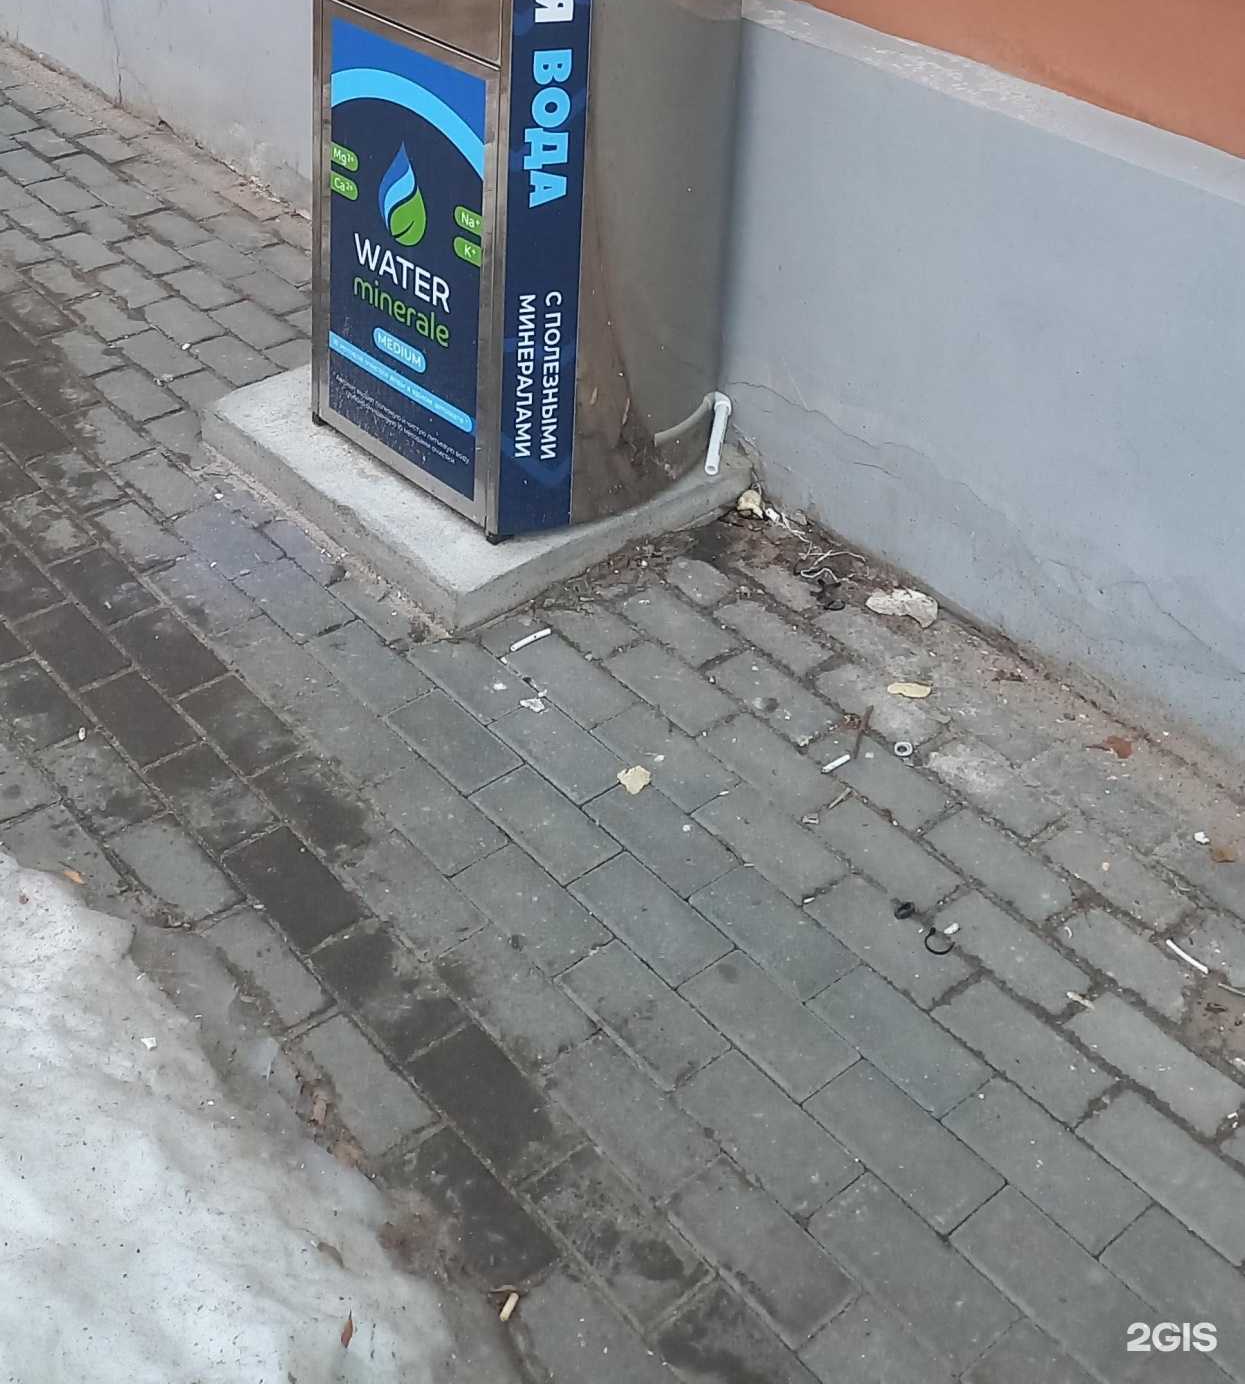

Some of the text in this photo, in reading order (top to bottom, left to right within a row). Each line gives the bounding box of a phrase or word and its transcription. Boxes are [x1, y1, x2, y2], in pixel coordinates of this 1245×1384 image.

[523, 48, 573, 209] ВОДА
[353, 276, 450, 347] minerale
[354, 232, 450, 313] WATER
[377, 331, 422, 367] MEDIUM
[514, 294, 537, 458] МИНЕРАЛАМИ
[540, 291, 562, 460] С ПОЛЕЗНЫМИ
